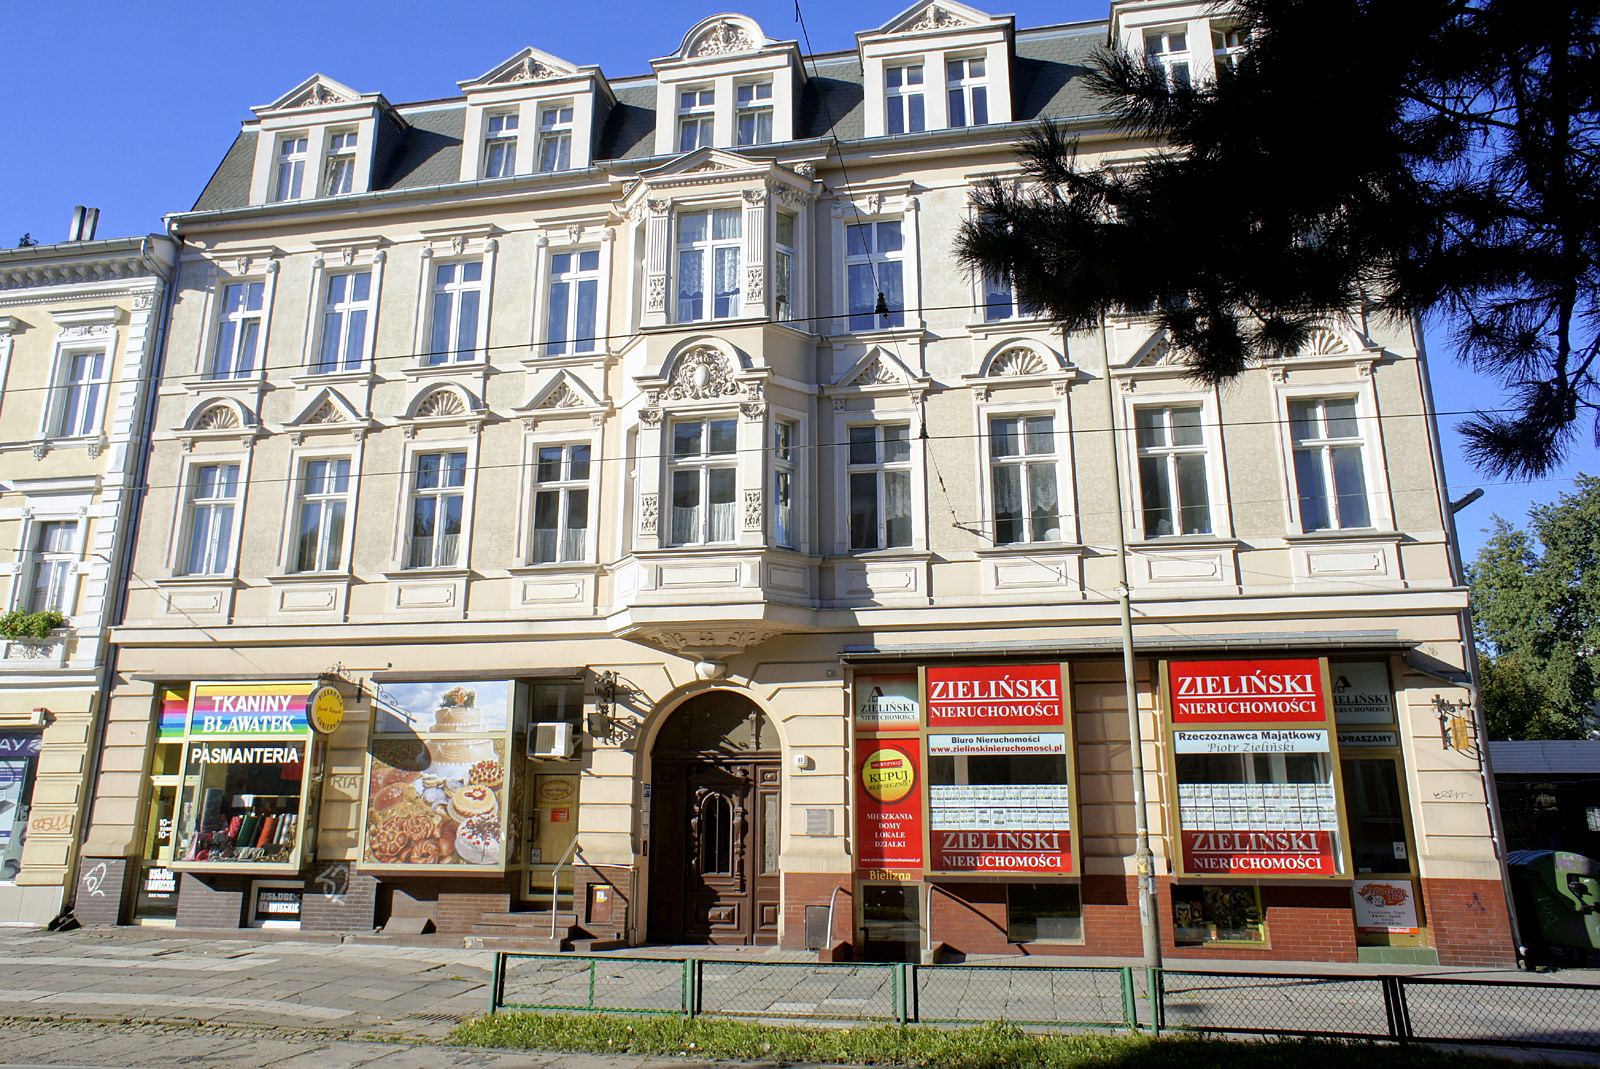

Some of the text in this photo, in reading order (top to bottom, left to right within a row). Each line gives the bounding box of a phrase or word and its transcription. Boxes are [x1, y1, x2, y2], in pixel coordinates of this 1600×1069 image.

[931, 675, 1059, 699] ZIELIŃSKI
[1177, 670, 1315, 695] ZIELIŃSKI
[211, 695, 293, 713] TKANINY
[1334, 692, 1388, 704] IELIŃSKI
[861, 701, 914, 713] ZIELIŃSKI
[931, 702, 1059, 718] NIERUCHOMOŚCI
[1178, 698, 1317, 715] NIERUCHOMOŚCI
[861, 713, 915, 721] NIERUCHOMOŚCI
[202, 715, 295, 733] BŁAWATEK
[976, 735, 1040, 743] Nieruchomości
[1178, 731, 1321, 742] Rzeczoznawca Majątkowy
[1338, 735, 1392, 743] APRASZAMY
[930, 744, 1063, 753] www.zielinskinieruchomosci.pl
[1207, 741, 1295, 753] Piotr Zieliński
[191, 747, 299, 763] PASMANTERIA
[869, 771, 908, 783] KUPUJ
[943, 830, 1060, 849] ZIELIŃSKI
[942, 853, 1062, 867] NIERUCHOMOŚCI
[1193, 855, 1322, 869] NIERUCHOMOŚCI
[869, 869, 911, 881] Bielizna
[258, 901, 300, 913] KRAWIECKIE
